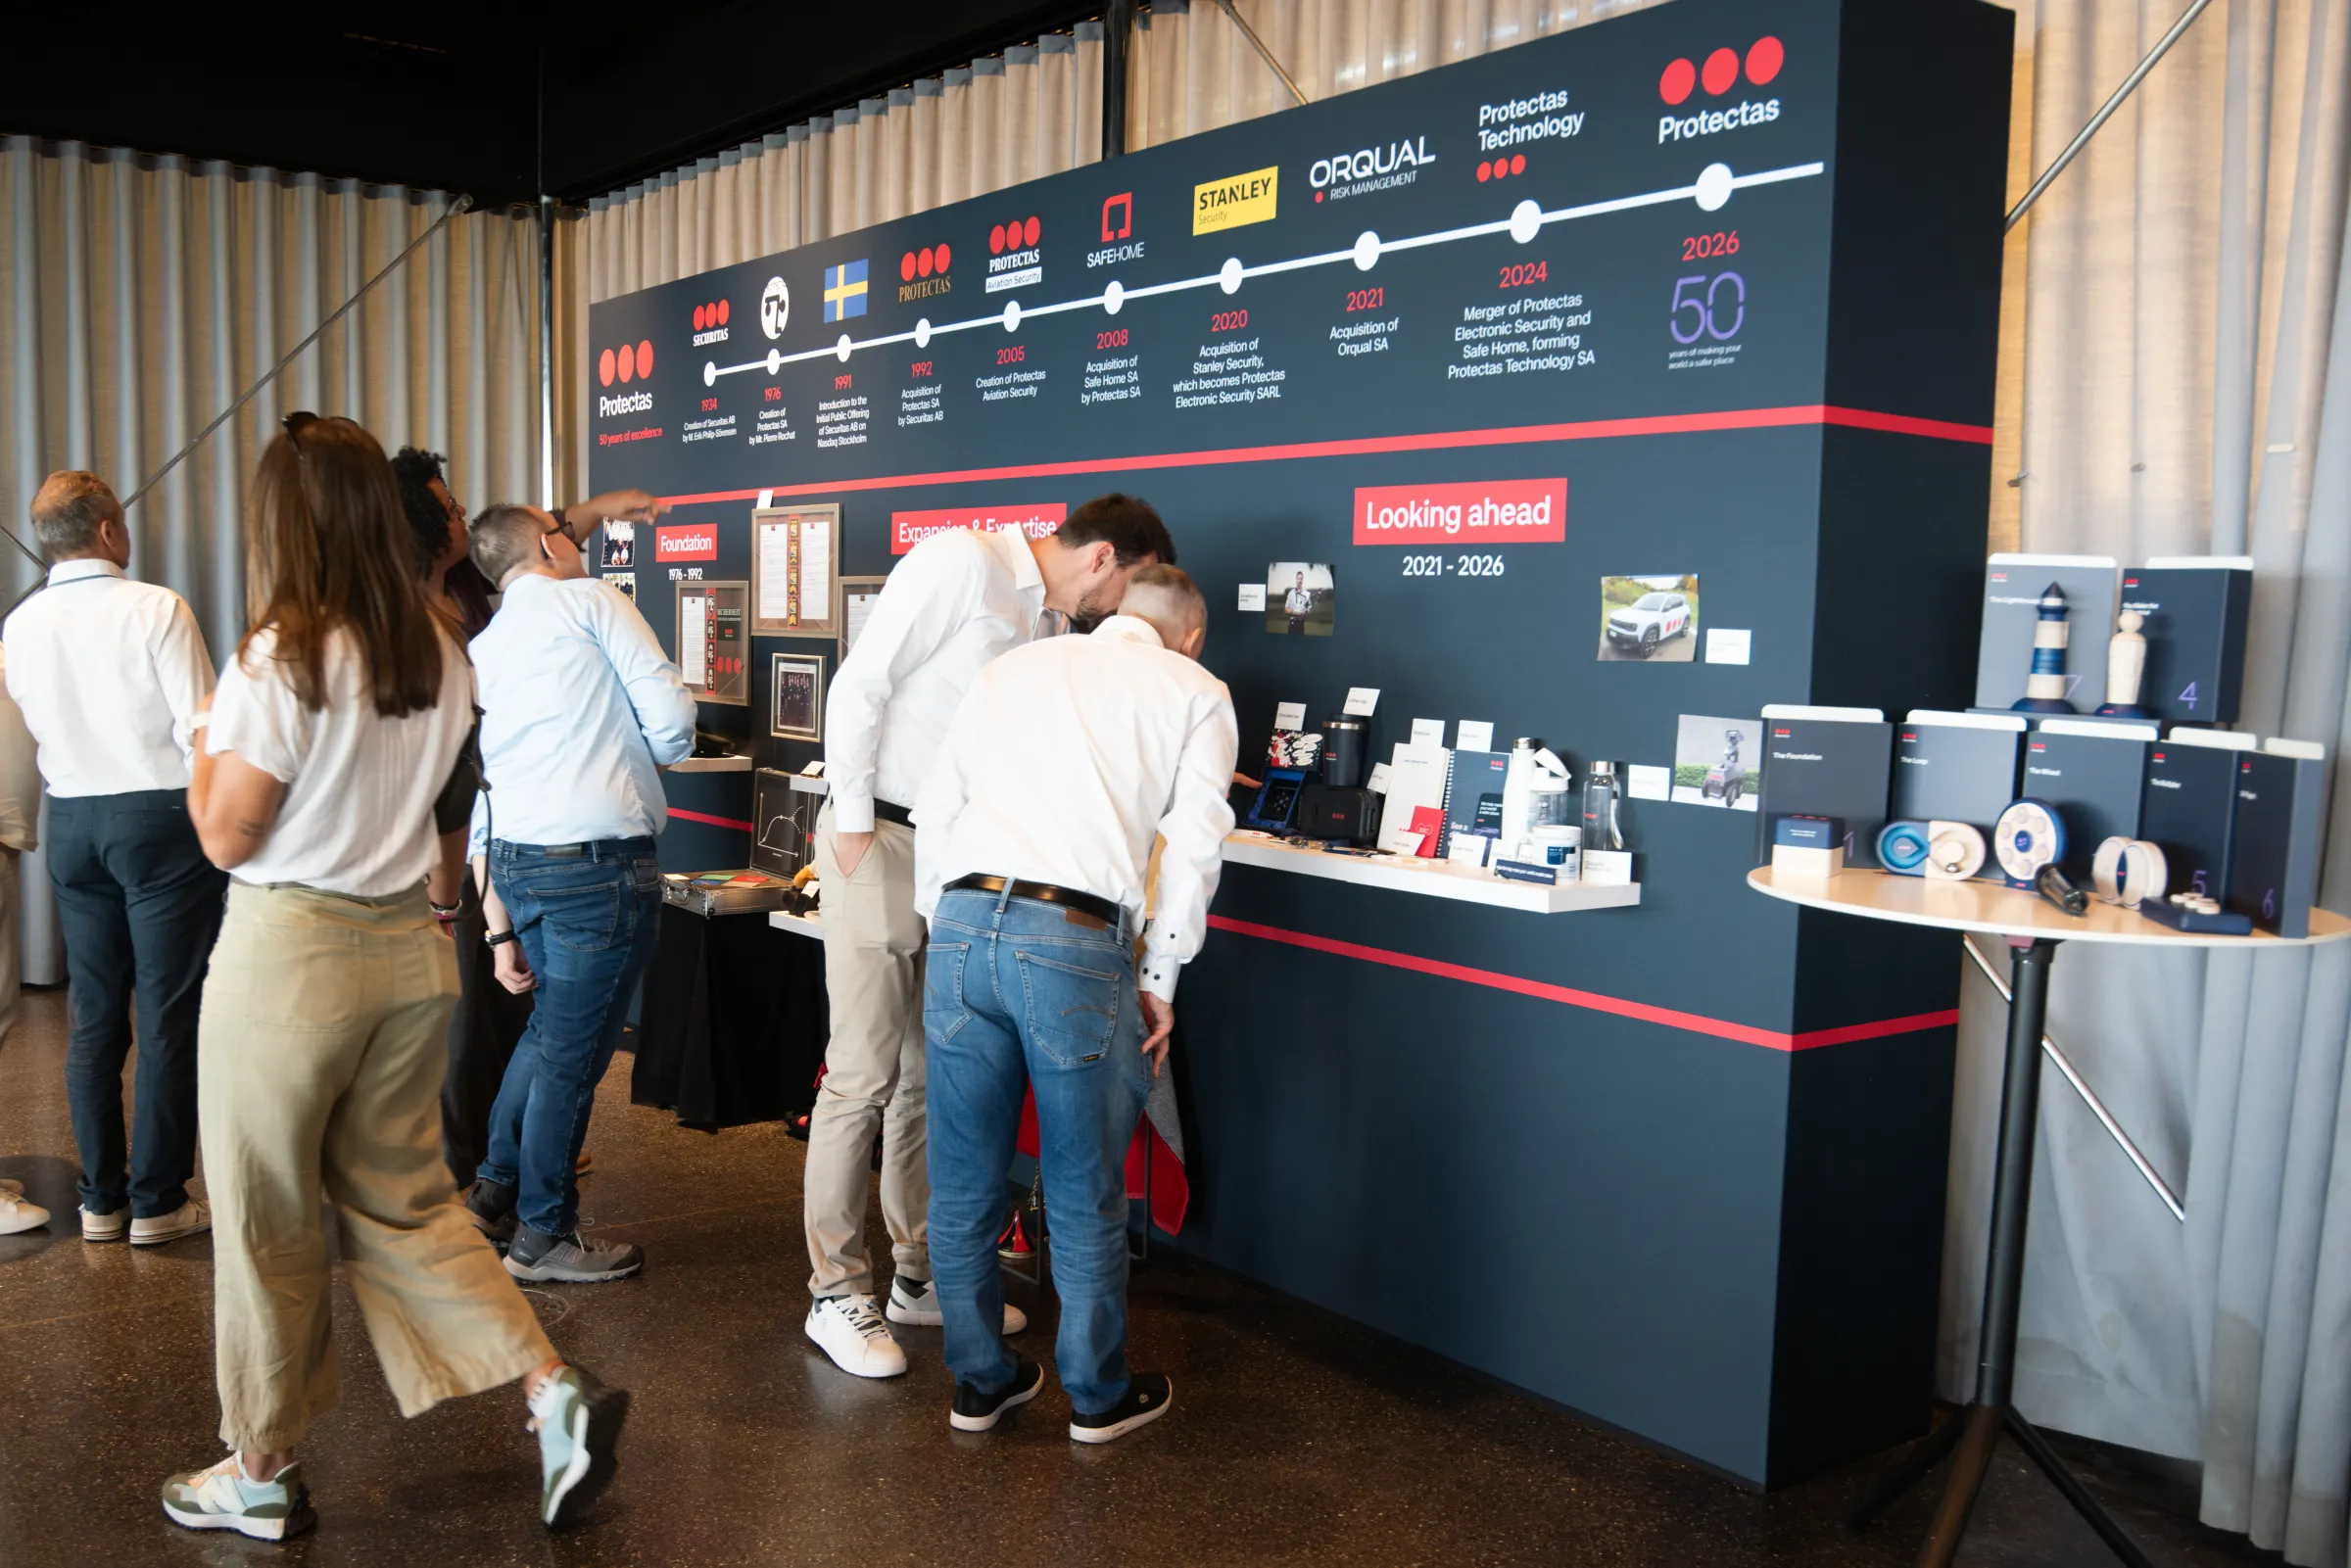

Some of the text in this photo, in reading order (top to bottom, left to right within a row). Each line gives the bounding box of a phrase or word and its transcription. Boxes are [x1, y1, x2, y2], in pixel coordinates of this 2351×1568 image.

[1479, 90, 1567, 127] Protectas
[1478, 111, 1585, 152] Technology
[1658, 98, 1781, 144] Protectas
[1310, 136, 1436, 188] ORQUAL
[1199, 177, 1271, 211] STANLEY
[1330, 170, 1417, 201] RISK MANAGEMENT
[1198, 210, 1227, 226] Security
[1086, 241, 1145, 268] SAFEHOME
[1681, 230, 1740, 261] 2026
[988, 249, 1040, 273] PROTECTAS
[986, 271, 1040, 291] Aviation Security
[1499, 261, 1548, 289] 2024
[898, 275, 951, 303] PROTECTAS
[1346, 287, 1384, 312] 2021
[1463, 294, 1583, 323] Merger of Protectas
[1670, 271, 1746, 344] 50
[1211, 309, 1248, 332] 2020
[1329, 317, 1399, 341] Acquisition of
[1455, 310, 1592, 342] Electronic Security and
[693, 328, 729, 347] SECURITAS
[1096, 329, 1128, 351] 2008
[1199, 337, 1260, 358] Acquisition of
[1337, 337, 1389, 357] Orqual SA
[1463, 332, 1580, 359] Safe Home, forming
[996, 345, 1025, 365] 2005
[1085, 355, 1138, 375] Acquisition of
[1193, 355, 1265, 376] Stanley Security,
[1448, 350, 1596, 380] Protectas Technology SA
[911, 360, 933, 379] 1992
[976, 369, 1046, 389] Creation of Protectas
[1084, 370, 1138, 389] Safe Home SA
[835, 375, 852, 391] 1991
[1173, 369, 1286, 393] which becomes Protectas
[764, 386, 782, 402] 1976
[901, 383, 941, 401] Acquisition of
[983, 386, 1037, 402] Aviation Security
[1080, 386, 1141, 405] by Protectas SA
[1176, 385, 1281, 408] Electronic Security SARL
[600, 392, 653, 418] Protectas
[701, 398, 718, 412] 1934
[759, 406, 786, 420] Creation of
[819, 396, 867, 411] Introduction to the
[901, 398, 940, 412] Protectas SA
[684, 415, 736, 431] Creation of Securitas AB
[756, 419, 788, 433] Protectas SA
[816, 407, 869, 424] Initial Public Offering
[897, 410, 943, 427] by Securitas AB
[599, 427, 663, 448] 50 years of excellence
[682, 433, 689, 444] by
[748, 435, 755, 447] by
[778, 430, 795, 441] Rochat
[818, 422, 866, 436] of Securitas AB on
[818, 434, 867, 450] Nasdaq Stockholm
[1367, 495, 1552, 535] Looking ahead
[660, 534, 712, 553] Foundation
[668, 568, 683, 581] 1976
[688, 567, 702, 581] 1992
[1402, 555, 1443, 577] 2021
[1458, 554, 1505, 576] 2026
[2178, 681, 2198, 710] 4
[1843, 831, 1854, 858] 1
[2262, 888, 2275, 920] 6
